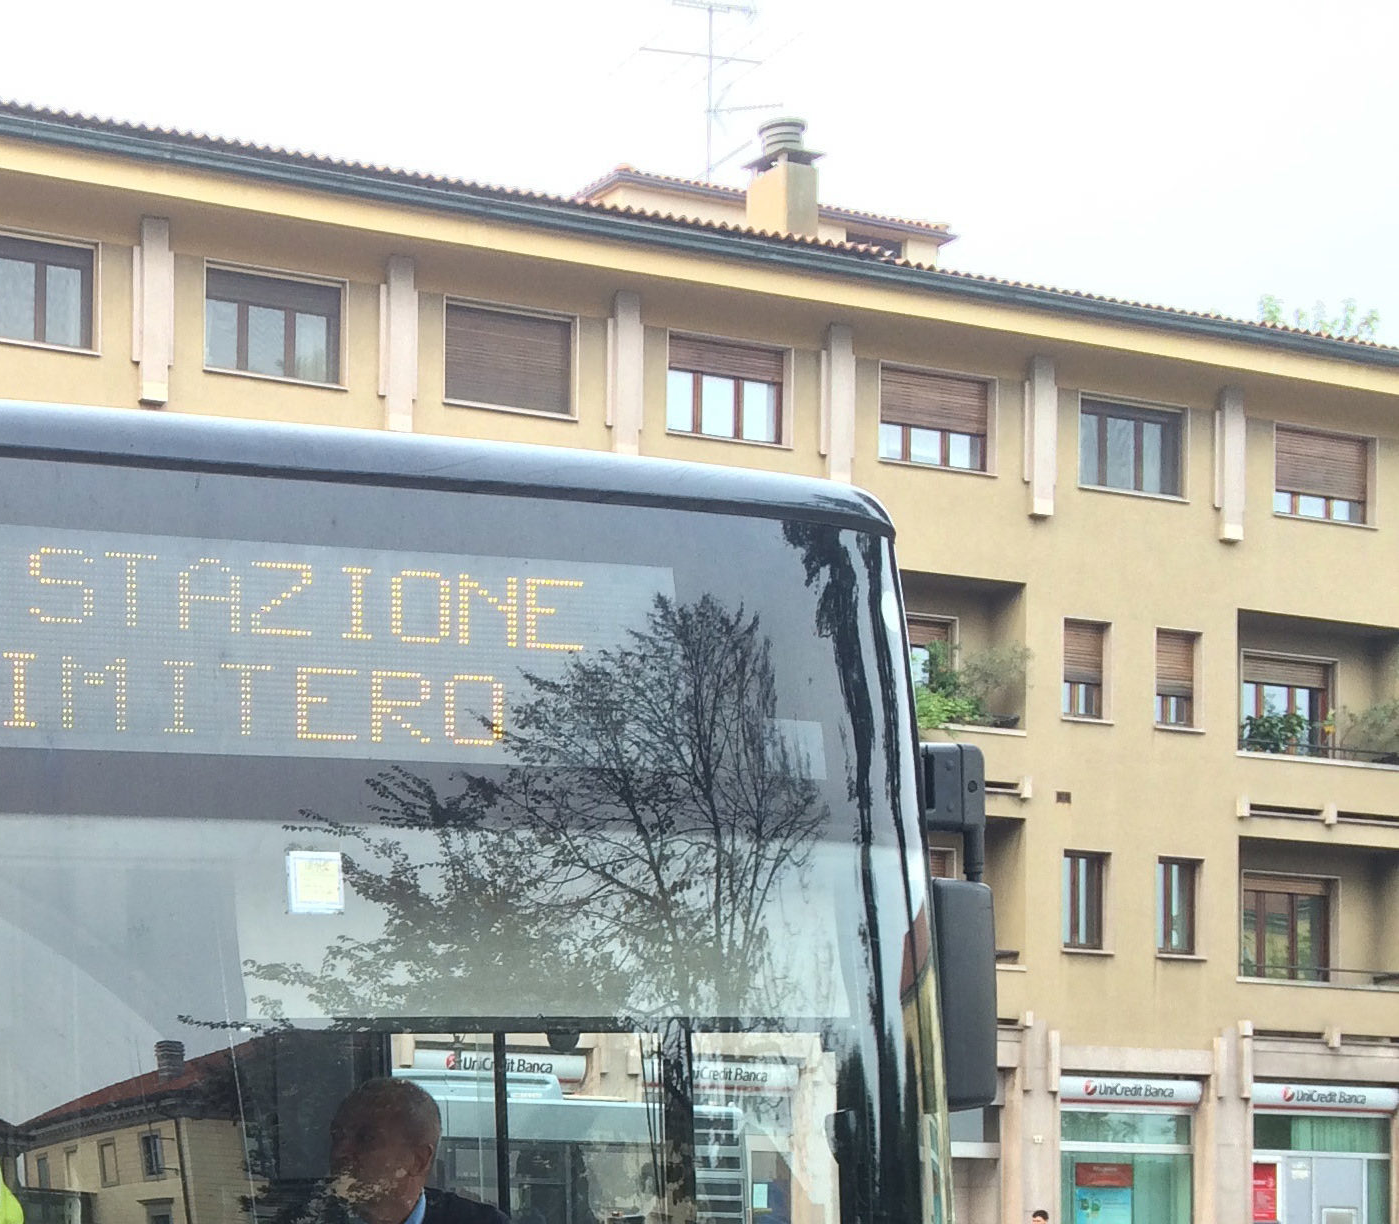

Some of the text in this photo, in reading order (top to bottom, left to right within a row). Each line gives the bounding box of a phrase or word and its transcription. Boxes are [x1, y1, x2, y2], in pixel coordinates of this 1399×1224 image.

[29, 546, 584, 650] STAZIONE
[516, 1059, 553, 1074] Banca
[734, 1067, 768, 1083] Banca
[1098, 1082, 1175, 1098] UniCredit Banca
[1296, 1089, 1367, 1105] UniCredit Banca
